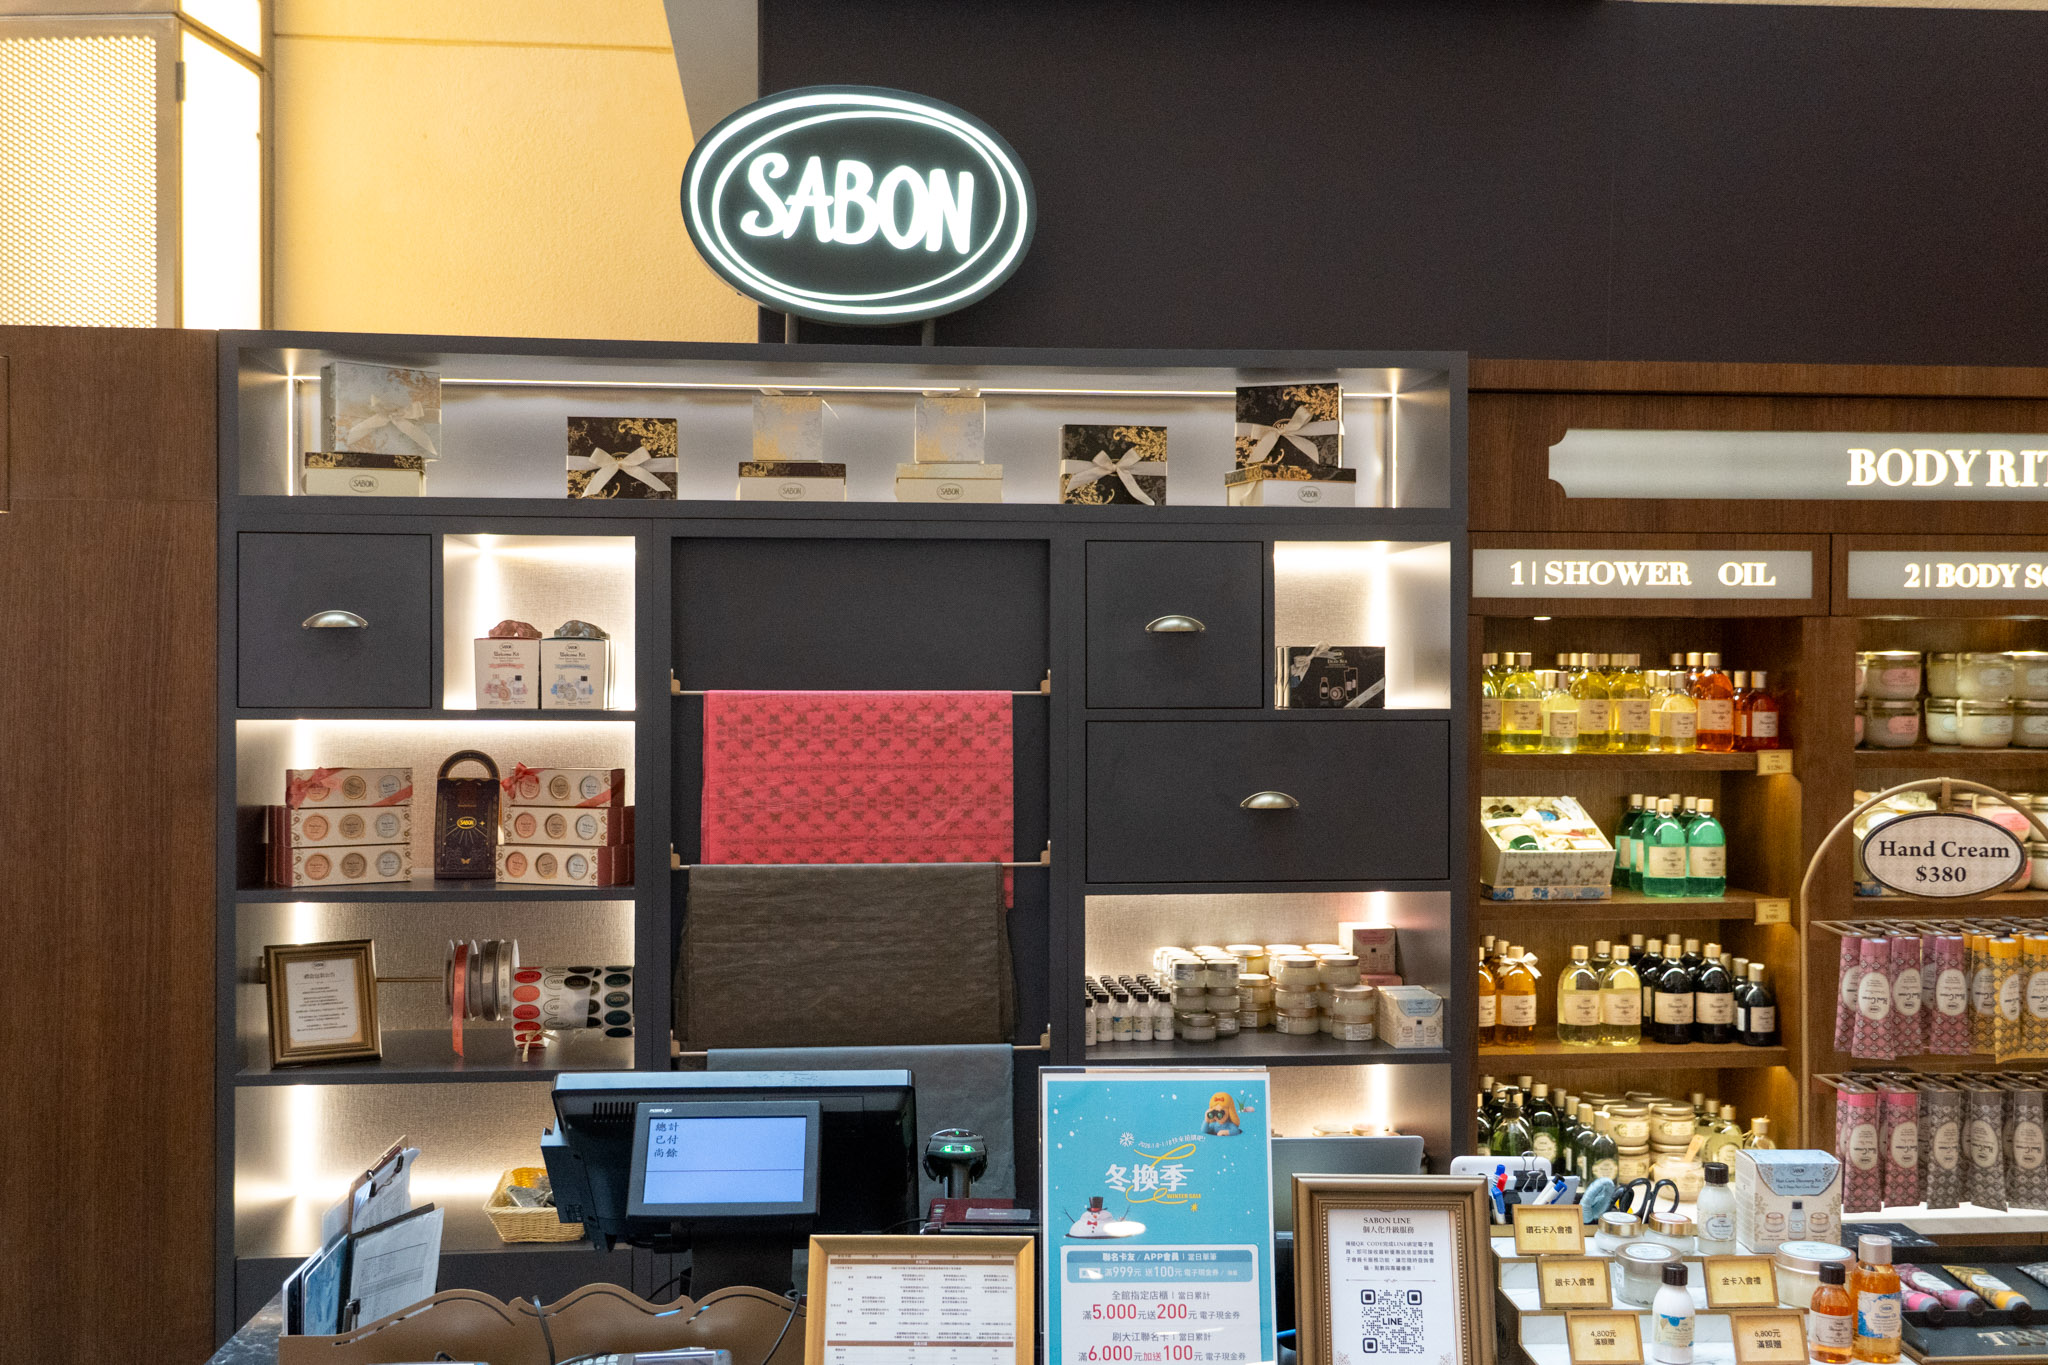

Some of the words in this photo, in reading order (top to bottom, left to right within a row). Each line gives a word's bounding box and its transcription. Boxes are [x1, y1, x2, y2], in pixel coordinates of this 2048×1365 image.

[740, 152, 974, 254] SABON
[1847, 448, 1982, 487] BODY
[353, 479, 374, 487] SABON
[1544, 560, 1692, 586] SHOWER
[1718, 561, 1776, 587] OIL
[1936, 563, 2021, 588] BODY
[2024, 563, 2048, 589] S
[1879, 840, 1936, 858] Hand
[1941, 841, 2011, 858] Cream
[1915, 864, 1967, 883] $380
[655, 1122, 680, 1132] 總計
[655, 1135, 679, 1144] 已付
[654, 1148, 679, 1158] 尚餘
[1104, 1163, 1194, 1193] 冬換季
[1143, 1252, 1180, 1262] APP會員
[1722, 1276, 1762, 1286] 金卡入會禮
[1112, 1290, 1169, 1301] 全館指定店櫃
[1178, 1290, 1211, 1301] 當日累計
[1199, 1310, 1241, 1320] 電子現金券
[1382, 1317, 1403, 1326] LINE
[1179, 1332, 1211, 1342] 當日累計
[1205, 1352, 1247, 1361] 電子現金券
